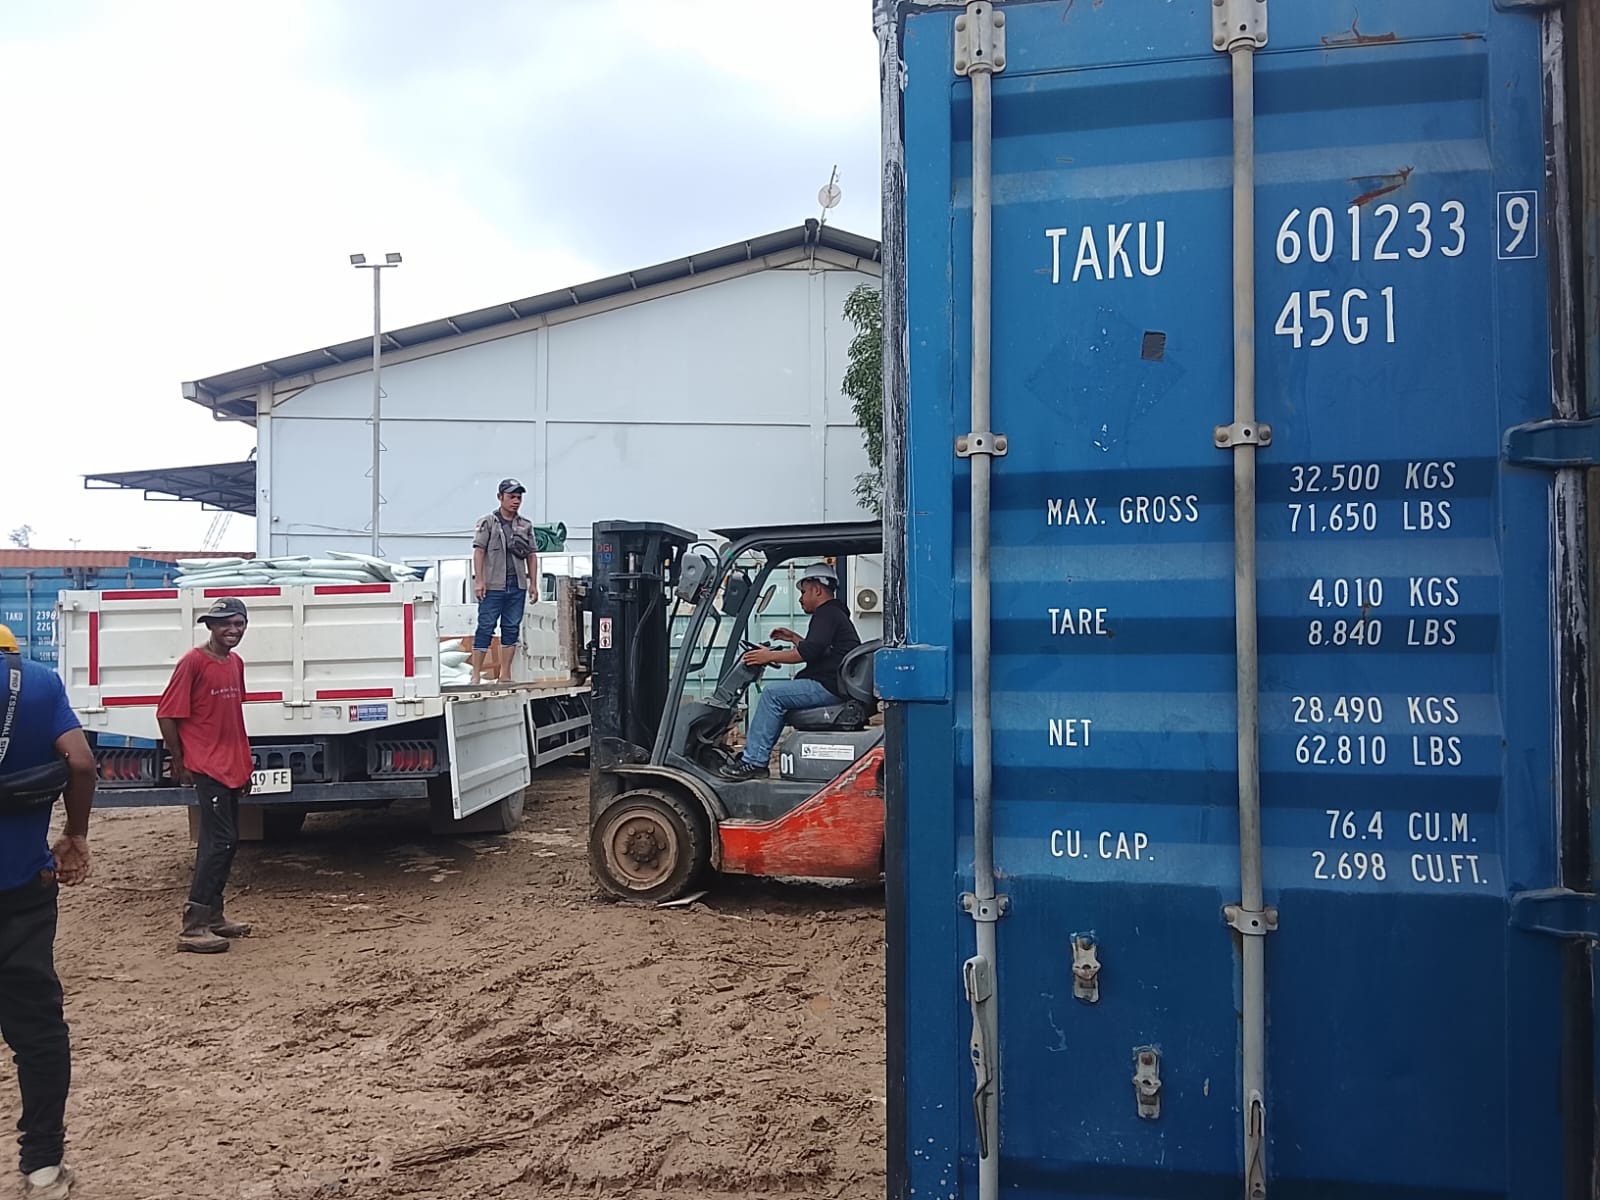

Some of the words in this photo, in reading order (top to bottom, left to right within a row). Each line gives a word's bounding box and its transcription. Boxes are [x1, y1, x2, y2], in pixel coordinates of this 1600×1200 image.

[1045, 221, 1166, 284] TAKU
[1275, 200, 1466, 264] 601233
[1504, 196, 1530, 252] 9
[1275, 286, 1396, 349] 45G1
[1405, 461, 1456, 489] KGS
[1047, 497, 1106, 525] MAX.
[1120, 494, 1199, 524] GROSS
[1403, 500, 1451, 530] LBS
[1409, 576, 1460, 607] KGS
[5, 611, 24, 621] TAKU
[1048, 608, 1108, 635] TARE
[1407, 618, 1457, 646] LBS
[1407, 696, 1459, 724] KGS
[1049, 718, 1092, 746] NET
[780, 753, 794, 774] 01
[1413, 735, 1462, 766] LBS
[272, 771, 289, 785] FE
[1326, 810, 1383, 840] 76.4
[1051, 829, 1088, 858] CU.
[1099, 831, 1154, 861] CAP.
